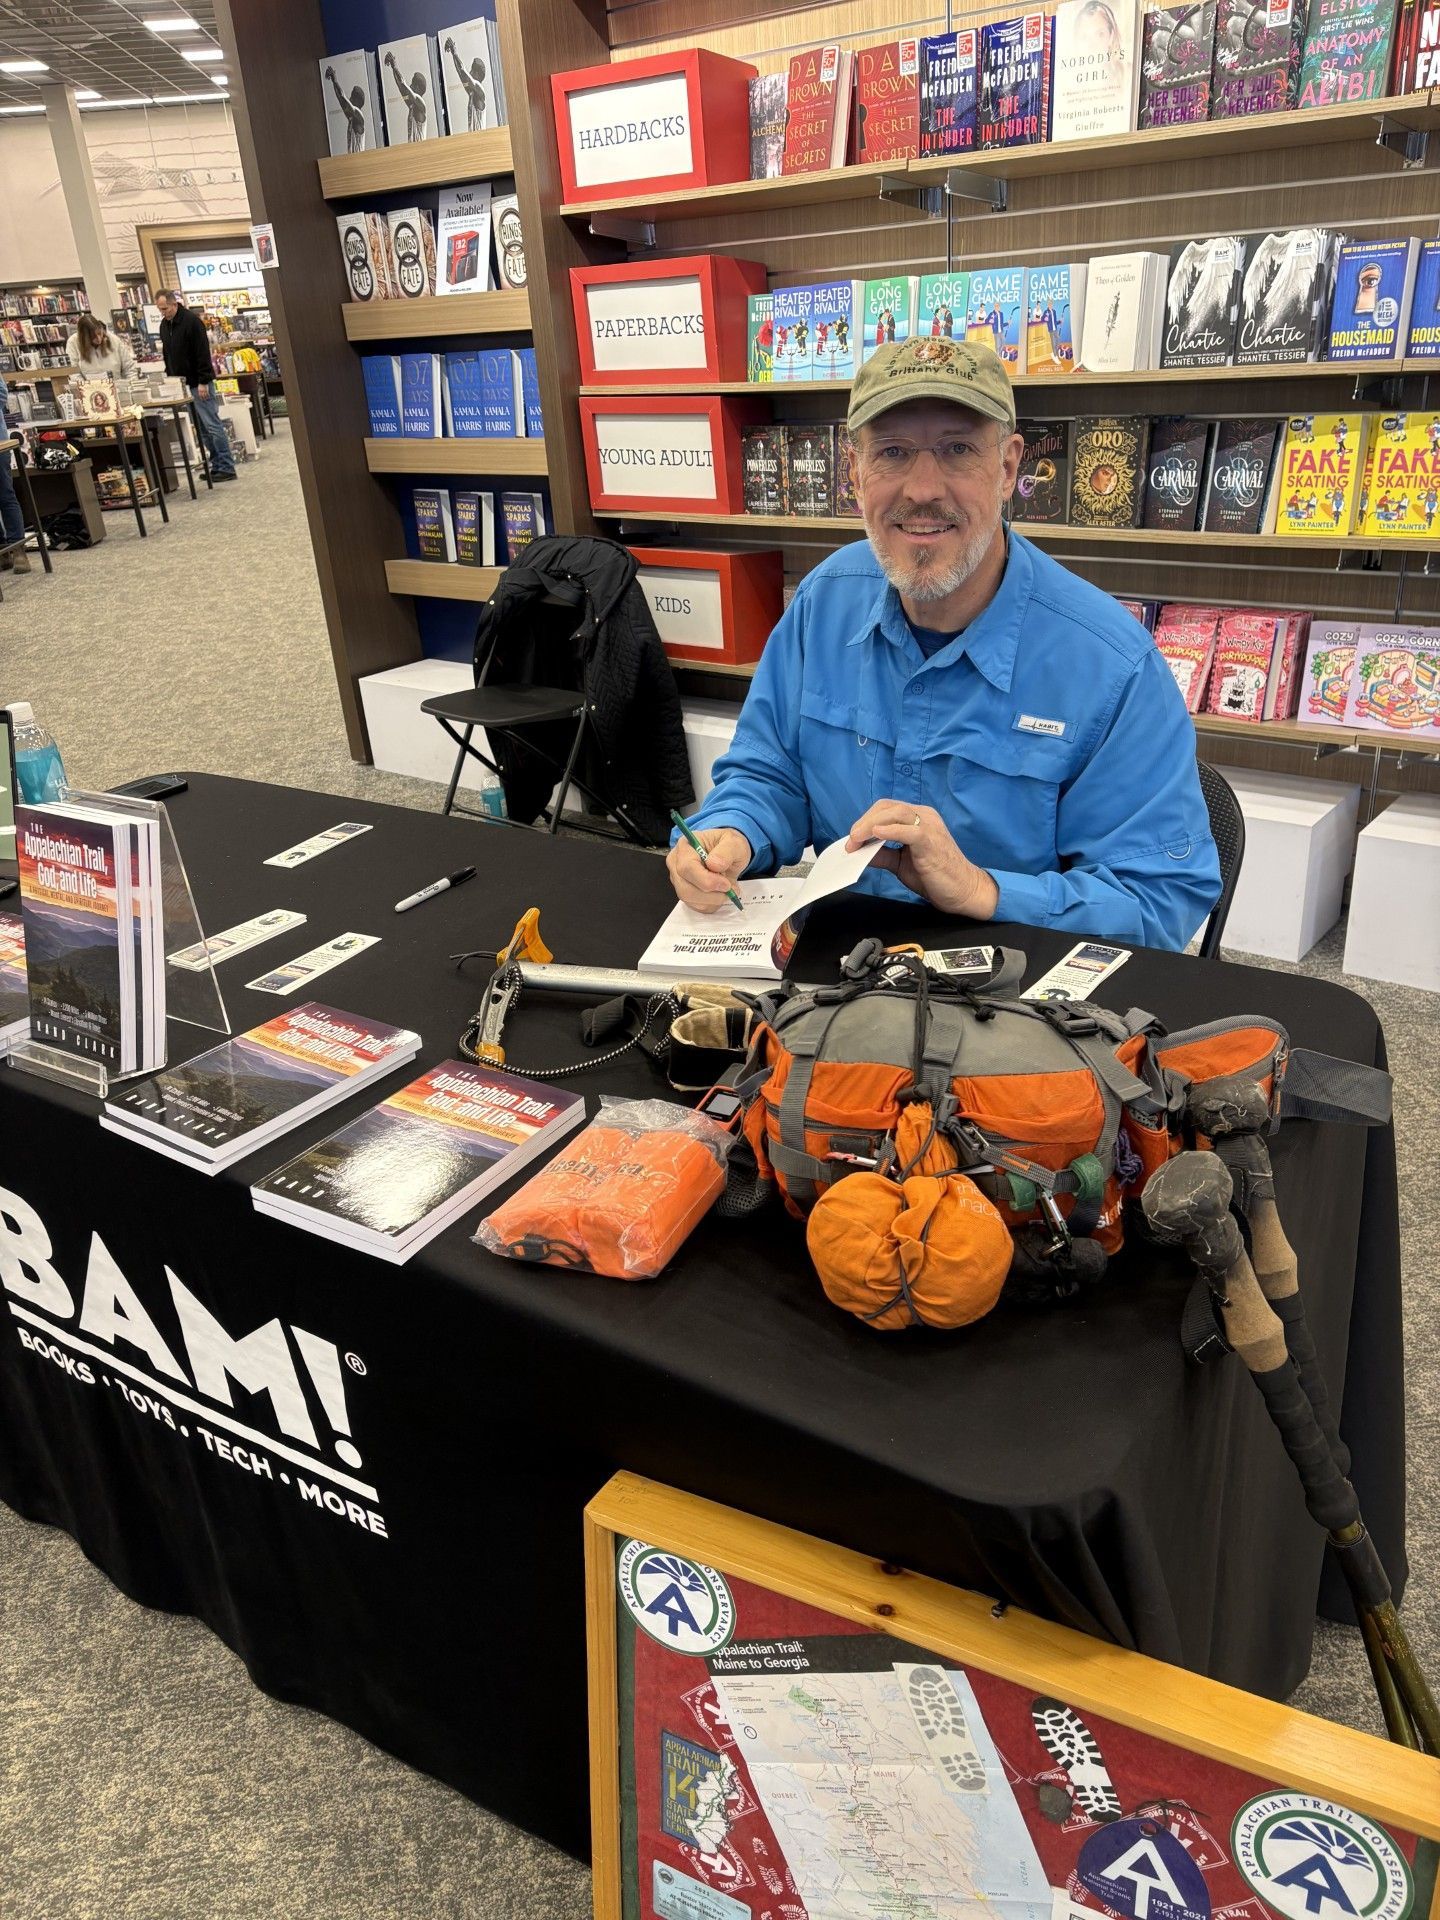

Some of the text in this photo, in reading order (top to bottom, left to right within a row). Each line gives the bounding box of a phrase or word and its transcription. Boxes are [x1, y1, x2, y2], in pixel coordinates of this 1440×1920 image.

[1320, 16, 1375, 33] FIRST LIE WINS
[1305, 25, 1385, 55] ANATOMY
[1061, 50, 1126, 70] NOBODY'S
[1321, 53, 1363, 70] OF AN
[983, 61, 1039, 88] McFADDEN
[1076, 69, 1109, 84] GIRL
[789, 80, 834, 104] BROWN
[863, 73, 917, 100] BROWN
[921, 75, 973, 99] McFADDEN
[1298, 70, 1376, 108] ALIBI
[883, 105, 897, 117] THE
[998, 95, 1019, 117] THE
[1058, 104, 1125, 121] Virginia Roberts
[802, 110, 815, 121] THE
[936, 107, 956, 127] THE
[579, 115, 686, 151] HARDBACKS
[789, 119, 828, 141] SECRET
[869, 115, 915, 137] SECRET
[981, 115, 1038, 143] INTRUDER
[801, 138, 810, 149] OF
[886, 136, 896, 146] OF
[921, 127, 973, 151] INTRUDER
[456, 191, 474, 204] Now
[445, 204, 485, 219] Available!
[345, 240, 366, 256] RINGS
[396, 234, 417, 250] RINGS
[187, 264, 216, 277] POP
[506, 257, 527, 278] FATE
[351, 272, 371, 292] FATE
[401, 267, 421, 288] FATE
[938, 274, 950, 282] THE
[972, 274, 1022, 292] GAME
[1030, 270, 1069, 291] GAME
[814, 286, 851, 301] HEATED
[870, 286, 902, 301] LONG
[926, 280, 962, 297] LONG
[1030, 287, 1069, 303] CHANGER
[774, 292, 812, 306] HEATED
[925, 294, 961, 310] GAME
[971, 289, 1020, 304] CHANGER
[774, 304, 812, 319] RIVALRY
[814, 299, 851, 315] RIVALRY
[870, 300, 902, 314] GAME
[594, 313, 706, 339] PAPERBACKS
[1358, 320, 1371, 329] THE
[1166, 324, 1226, 355] Chaotic
[1240, 318, 1306, 351] Chaotic
[1331, 328, 1395, 348] HOUSEMAID
[1237, 353, 1273, 364] SHANTEL
[1274, 351, 1307, 361] TESSIER
[1332, 347, 1391, 358] FREIDA McFADDEN
[1411, 346, 1436, 355] FREIDA
[1163, 356, 1196, 368] SHANTEL
[1197, 355, 1226, 365] TESSIER
[481, 356, 508, 384] 107
[889, 366, 974, 381] Brittany Club
[370, 409, 396, 418] KAMALA
[404, 407, 430, 417] KAMALA
[454, 407, 481, 417] KAMALA
[484, 406, 511, 416] KAMALA
[373, 422, 398, 433] HARRIS
[404, 421, 430, 432] HARRIS
[456, 421, 482, 431] HARRIS
[485, 420, 512, 432] HARRIS
[1091, 430, 1124, 449] ORO
[598, 447, 714, 468] YOUNG ADULT
[1288, 448, 1353, 474] FAKE
[1378, 448, 1440, 474] FAKE
[746, 459, 778, 473] POWERLESS
[793, 458, 826, 473] POWERLESS
[1150, 458, 1199, 491] CARAVAL
[1213, 459, 1264, 492] CARAVAL
[1286, 475, 1349, 489] SKATING
[1376, 475, 1440, 489] SKATING
[414, 500, 439, 509] NICHOLAS
[456, 502, 477, 511] NICHOLAS
[503, 504, 532, 513] NICHOLAS
[417, 509, 438, 518] SPARKS
[458, 511, 476, 520] SPARKS
[506, 513, 531, 522] SPARKS
[1086, 518, 1116, 527] ALEX ASTER
[417, 531, 443, 539] SHYAMALAN
[457, 534, 478, 542] SHYAMALAN
[515, 528, 532, 536] NIGHT
[654, 596, 692, 615] KIDS
[1324, 631, 1354, 641] COZY
[1375, 633, 1406, 644] COZY
[30, 822, 44, 835] THE
[24, 831, 109, 876] Appalachian Trail,
[37, 861, 97, 899] God, and Life
[688, 936, 753, 946] God, and Life
[672, 944, 763, 954] Appalachian Trail,
[285, 1012, 362, 1045] Appalachian
[76, 1034, 115, 1059] CLARK
[455, 1070, 478, 1081] THE
[427, 1073, 555, 1120] Appalachian Trail,
[423, 1091, 517, 1128] God, and Life
[0, 1185, 363, 1469] BAM!
[16, 1326, 390, 1539] BOOKS TOYS TECH MORE
[622, 1541, 730, 1645] APPALACHIA ONSERVANCY
[713, 1640, 806, 1656] ppalachian Trail:
[713, 1655, 810, 1671] Maine to Georgia
[873, 1770, 897, 1779] MAINE
[771, 1791, 798, 1800] QUEBEC
[1175, 1813, 1187, 1824] TO
[1240, 1797, 1293, 1879] APPALACHIAN
[1298, 1797, 1355, 1825] TRAIL
[1088, 1871, 1128, 1893] Appalachian
[1100, 1890, 1115, 1900] Trail
[1151, 1898, 1174, 1911] 1921
[1183, 1909, 1207, 1920] 2021
[1225, 1908, 1251, 1919] TRAIL
